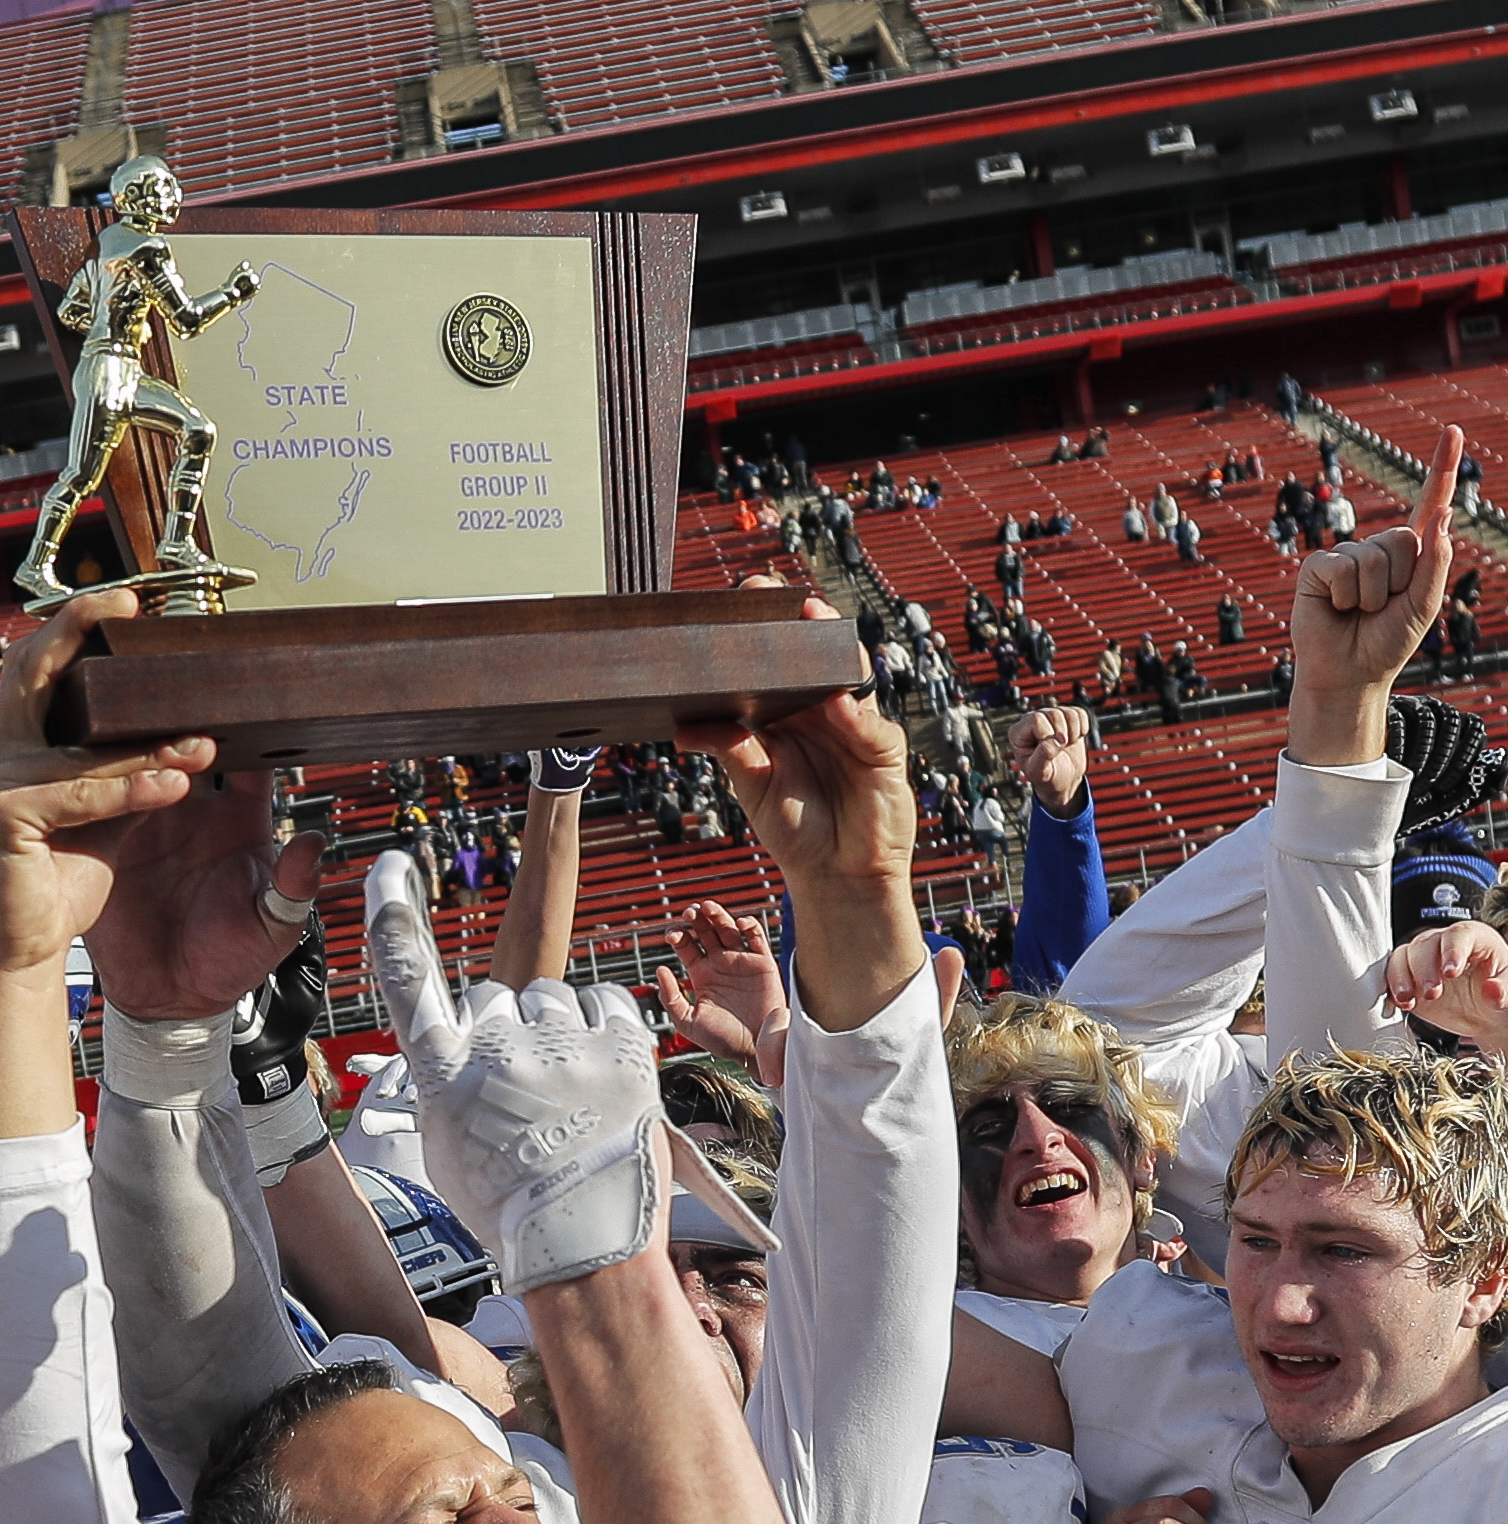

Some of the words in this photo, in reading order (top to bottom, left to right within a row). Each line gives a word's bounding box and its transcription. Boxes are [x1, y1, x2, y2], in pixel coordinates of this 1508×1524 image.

[265, 385, 348, 407] STATE
[233, 437, 392, 460] CHAMPIONS
[450, 442, 553, 464] FOOTBALL
[461, 475, 528, 497] GROUP
[535, 475, 547, 496] II
[457, 508, 564, 531] 2022-2023
